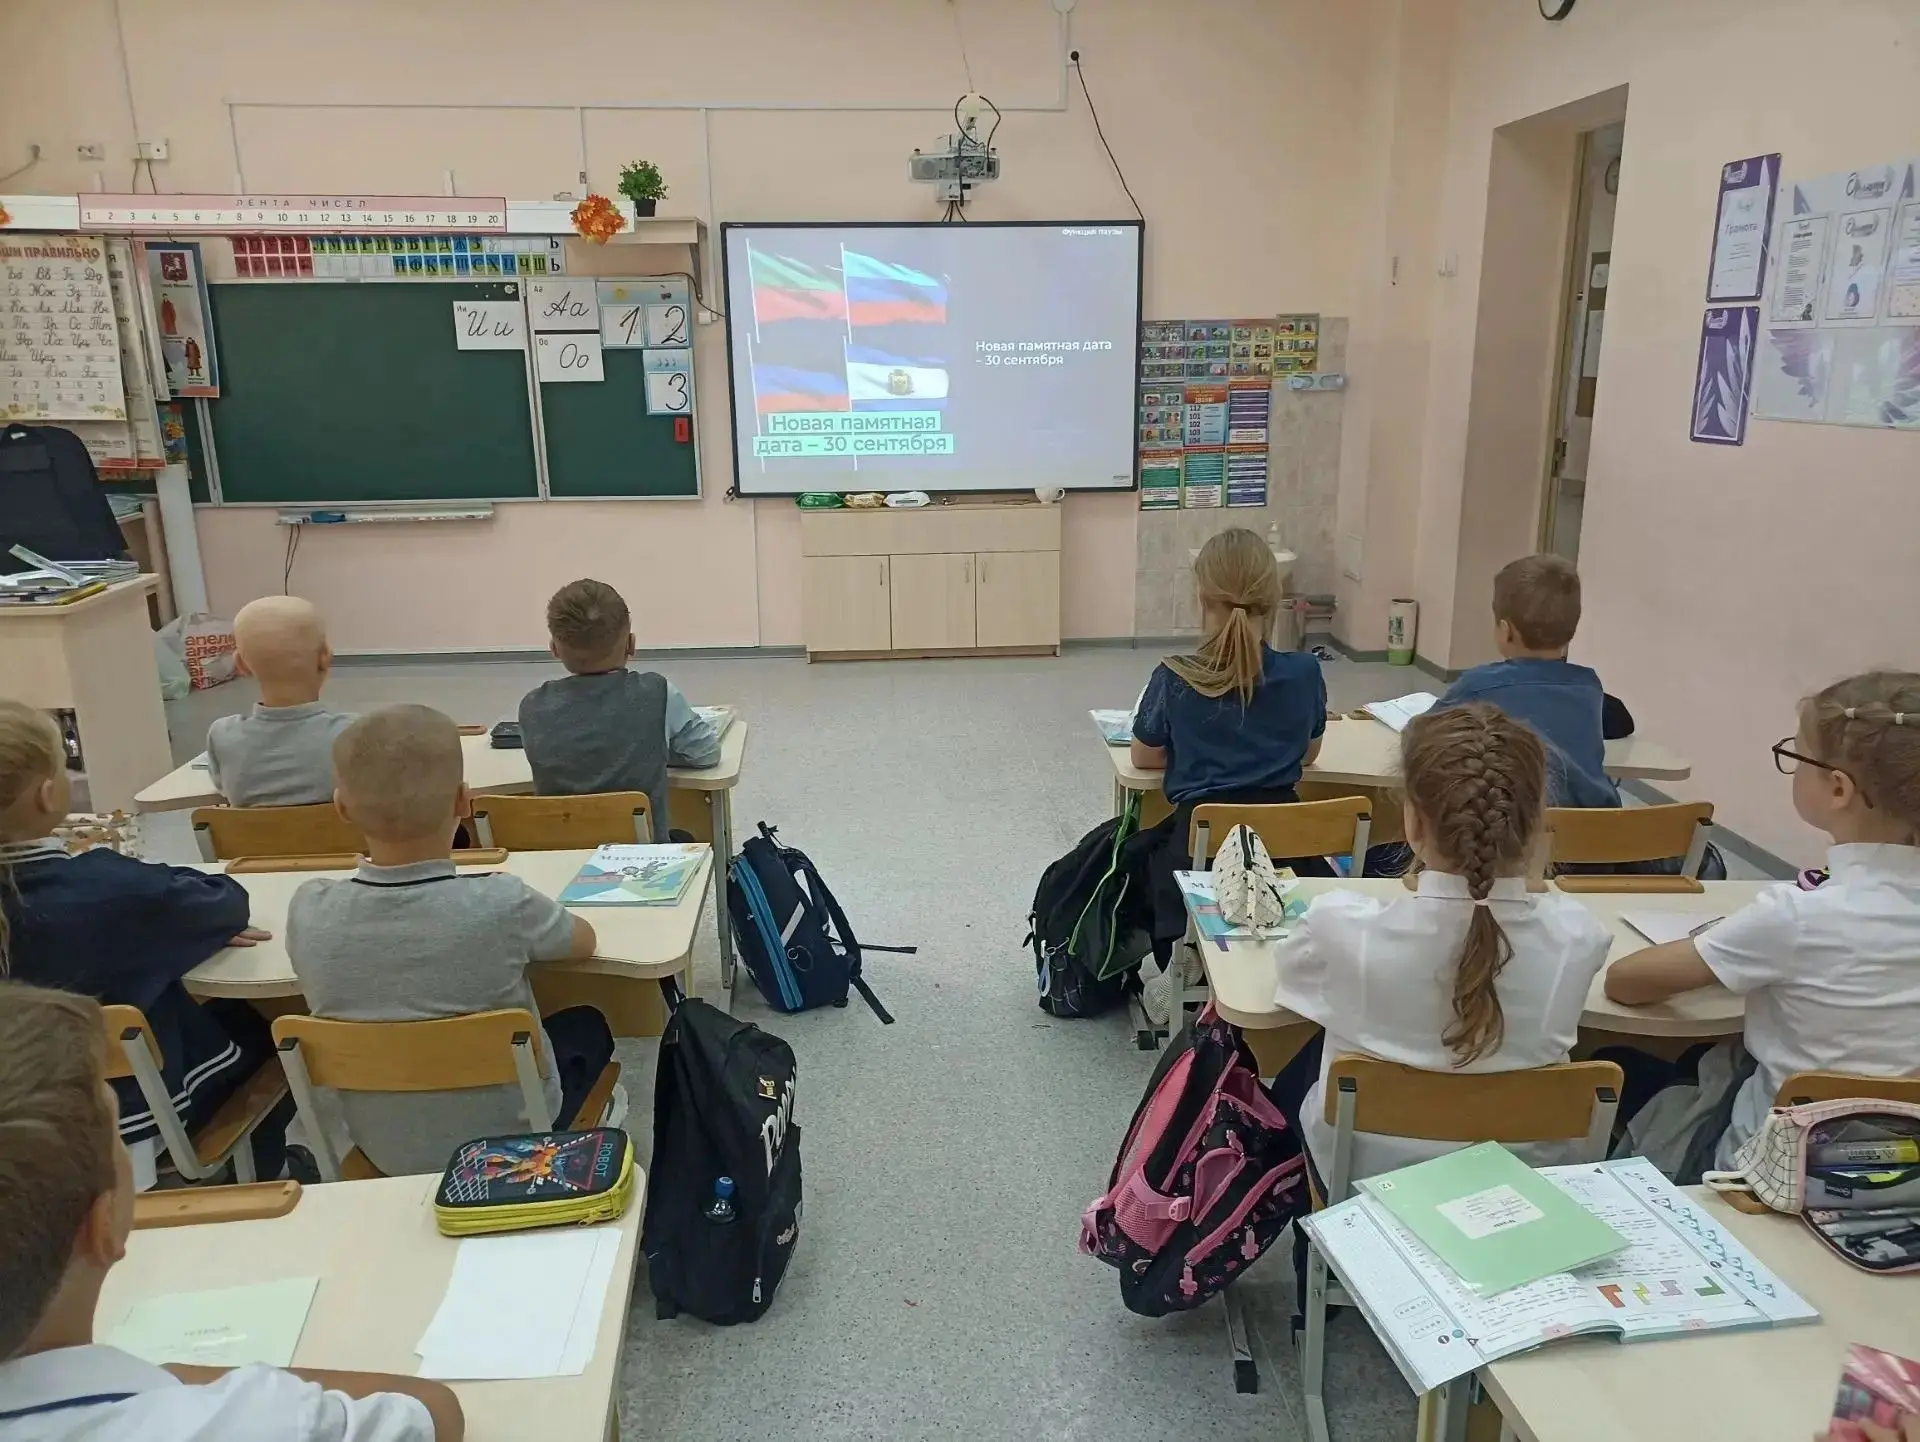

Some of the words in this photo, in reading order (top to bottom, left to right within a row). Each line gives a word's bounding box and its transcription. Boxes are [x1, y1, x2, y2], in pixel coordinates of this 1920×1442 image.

[236, 199, 290, 207] ЛЕНТА
[309, 199, 367, 208] ЧИСЕЛ
[86, 212, 91, 220] 1
[107, 212, 114, 220] 2
[129, 212, 136, 220] 3
[151, 212, 157, 220] 4
[173, 212, 179, 221] 5
[194, 212, 200, 221] 6
[216, 212, 222, 221] 7
[236, 212, 242, 221] 8
[257, 212, 263, 221] 9
[278, 212, 288, 222] 10
[299, 213, 309, 222] 11
[320, 213, 330, 222] 12
[341, 213, 351, 222] 13
[362, 214, 373, 222] 14
[383, 214, 393, 223] 15
[405, 214, 415, 223] 16
[425, 214, 435, 224] 17
[447, 214, 457, 224] 18
[467, 214, 478, 224] 19
[488, 214, 499, 224] 20
[24, 246, 100, 259] ПРАВИЛЬНО
[542, 291, 590, 318] Аа
[467, 310, 515, 337] Ии
[619, 305, 641, 345] 1
[660, 305, 688, 345] 2
[559, 343, 590, 369] Оо
[975, 341, 1016, 352] Новая
[1018, 340, 1080, 352] памятная
[1082, 340, 1113, 352] дата
[984, 354, 1001, 366] 30
[1003, 353, 1064, 367] сентября
[665, 372, 688, 411] 3
[772, 415, 834, 431] Новая
[840, 415, 937, 431] памятная
[756, 438, 803, 455] дата
[823, 436, 847, 452] 30
[852, 433, 948, 454] сентября
[594, 1143, 614, 1178] ROBOT
